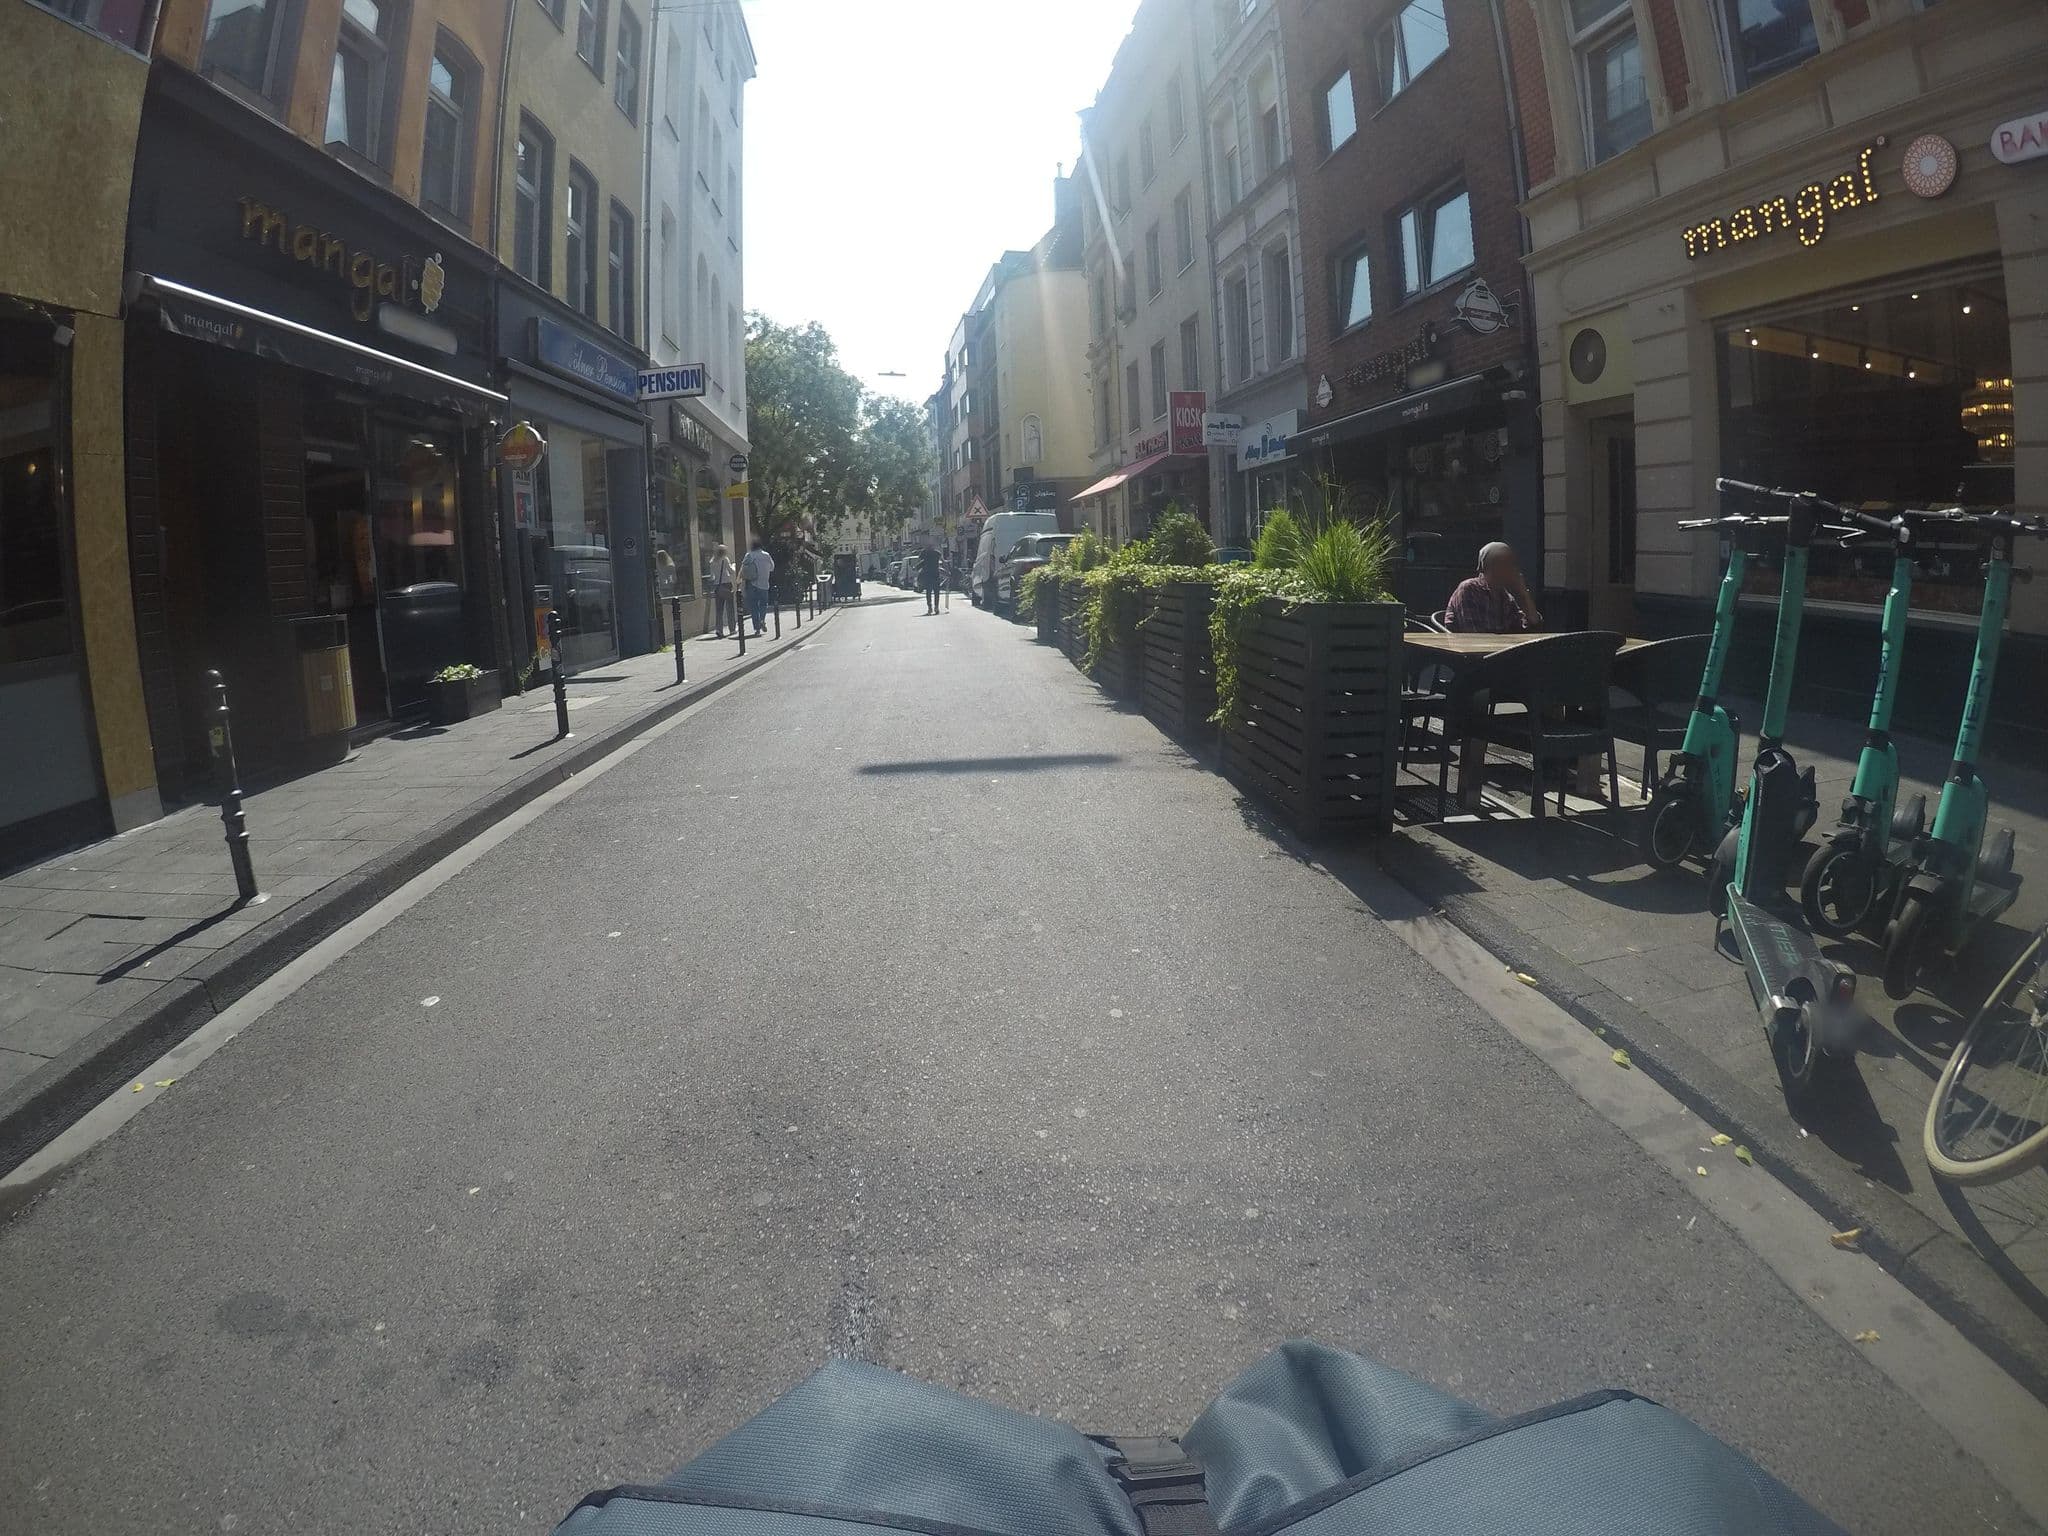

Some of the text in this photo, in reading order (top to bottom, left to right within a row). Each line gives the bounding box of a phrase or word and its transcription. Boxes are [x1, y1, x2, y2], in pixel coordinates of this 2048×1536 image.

[1681, 147, 1879, 259] mangal
[237, 195, 414, 322] mangal
[183, 312, 234, 337] mangal
[1345, 321, 1429, 393] mangal
[639, 369, 701, 394] PENSION
[1176, 407, 1203, 428] KIOSK
